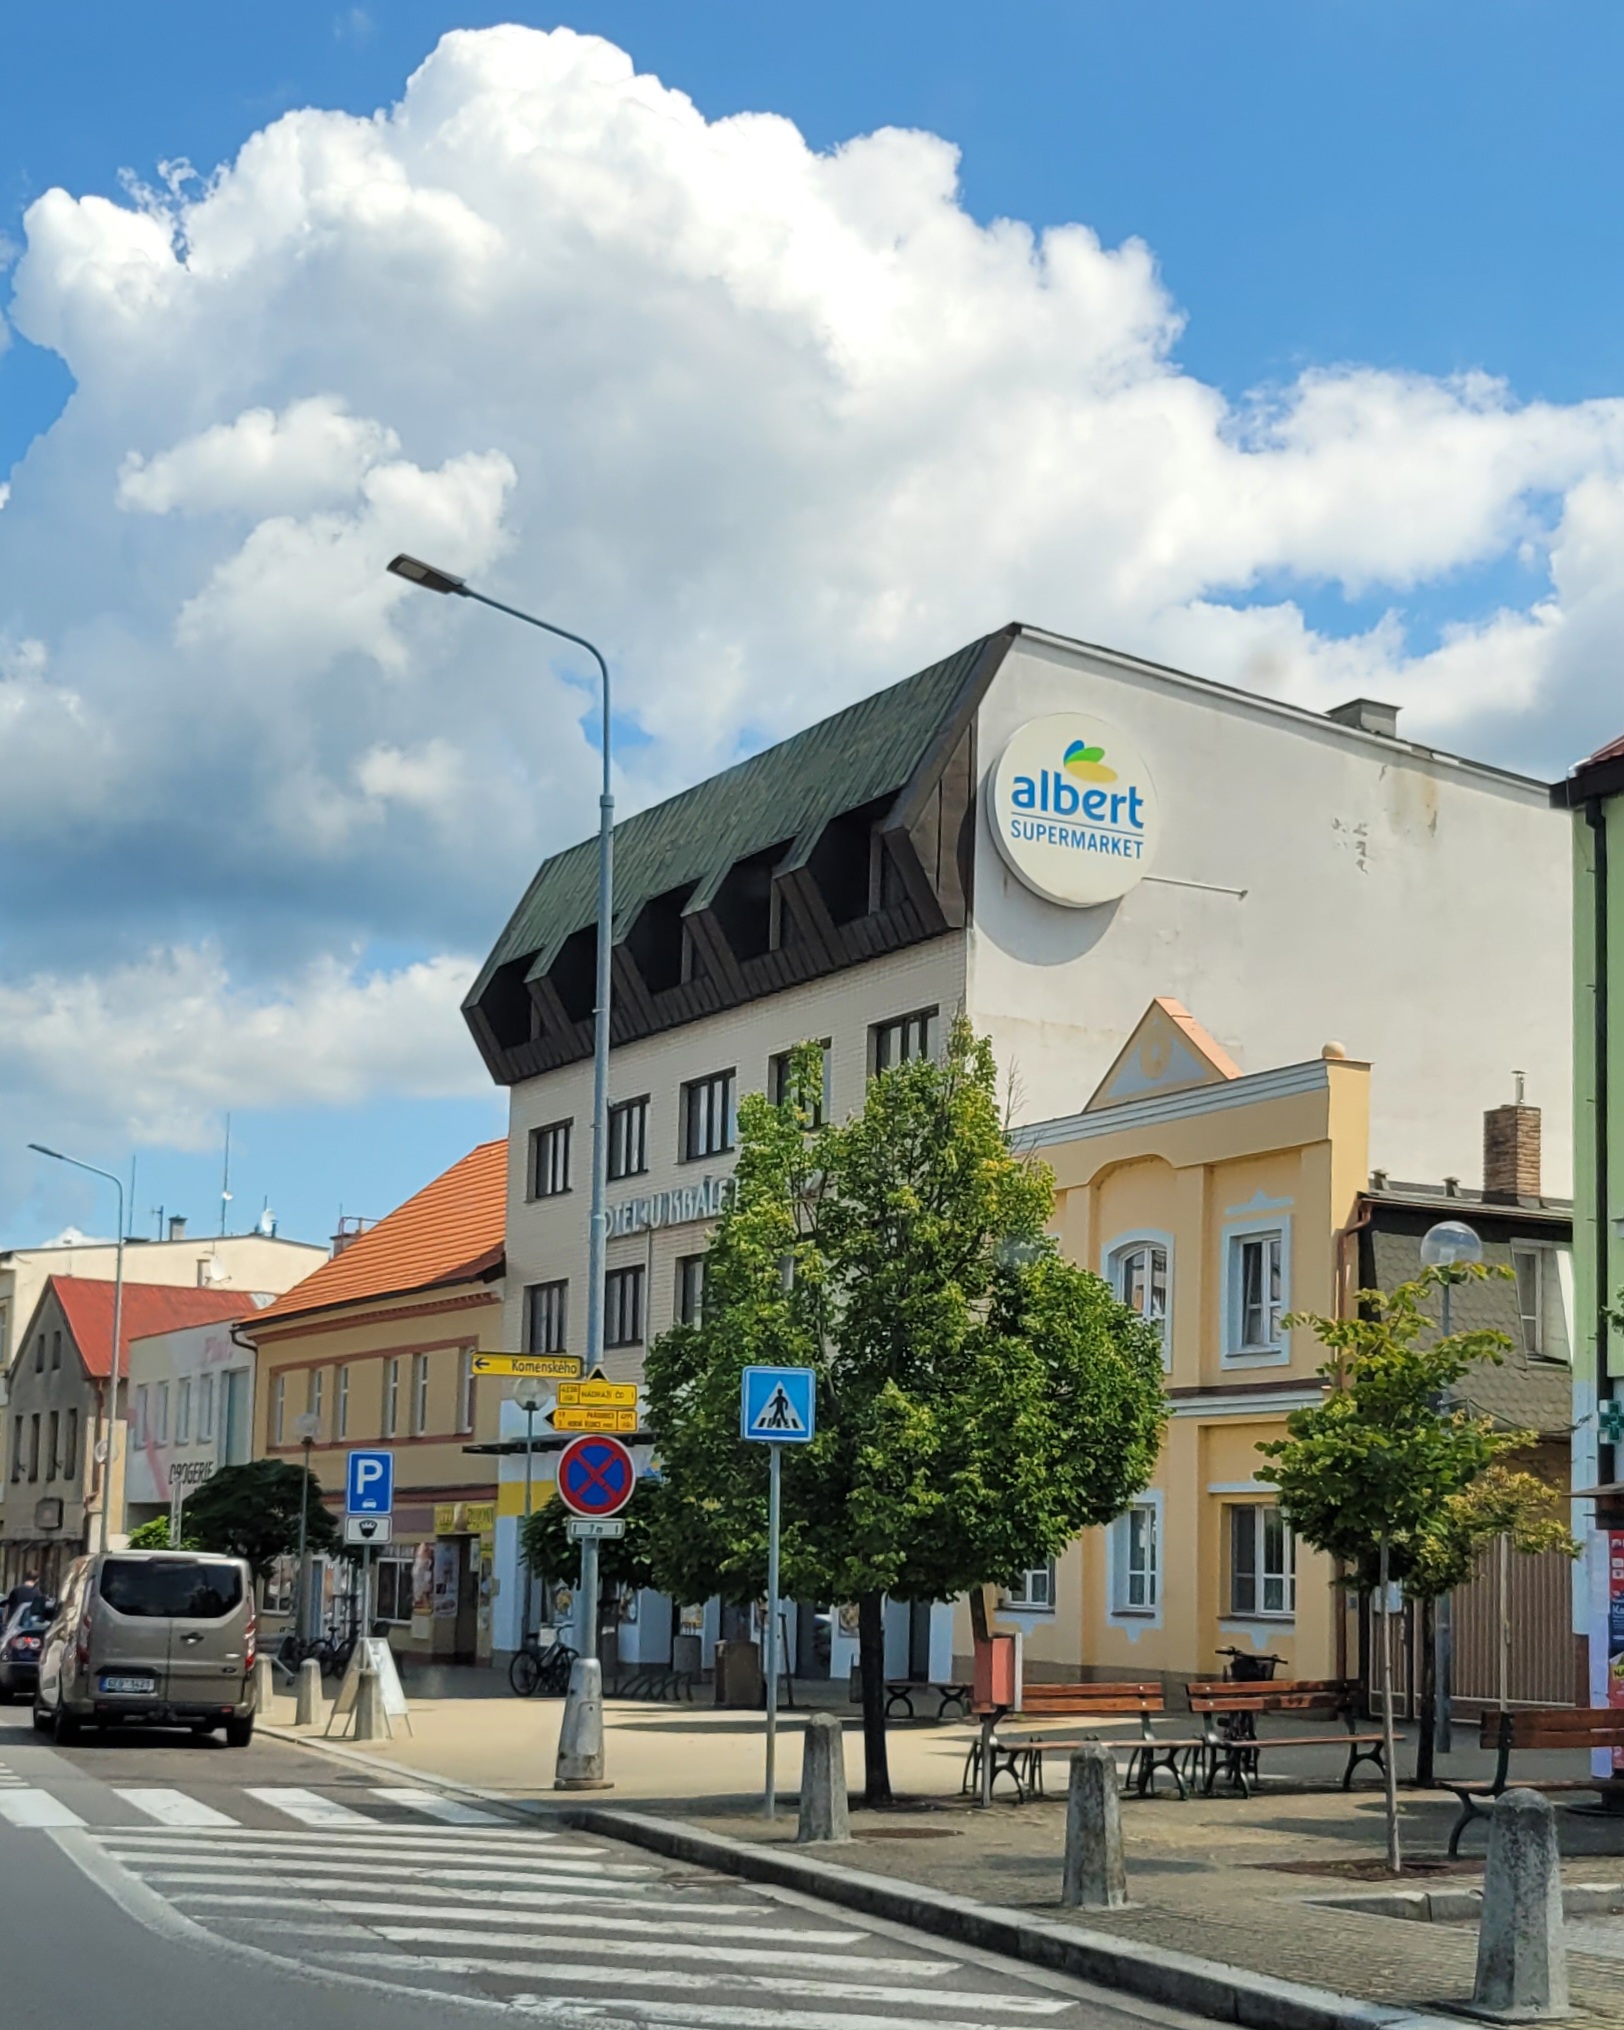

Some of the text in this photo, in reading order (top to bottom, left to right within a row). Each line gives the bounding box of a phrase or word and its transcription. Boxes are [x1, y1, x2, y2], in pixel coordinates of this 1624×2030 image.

[1011, 769, 1144, 829] albert
[1011, 820, 1144, 859] SUPERMARKET
[511, 1358, 578, 1374] Komenského
[356, 1458, 384, 1495] P
